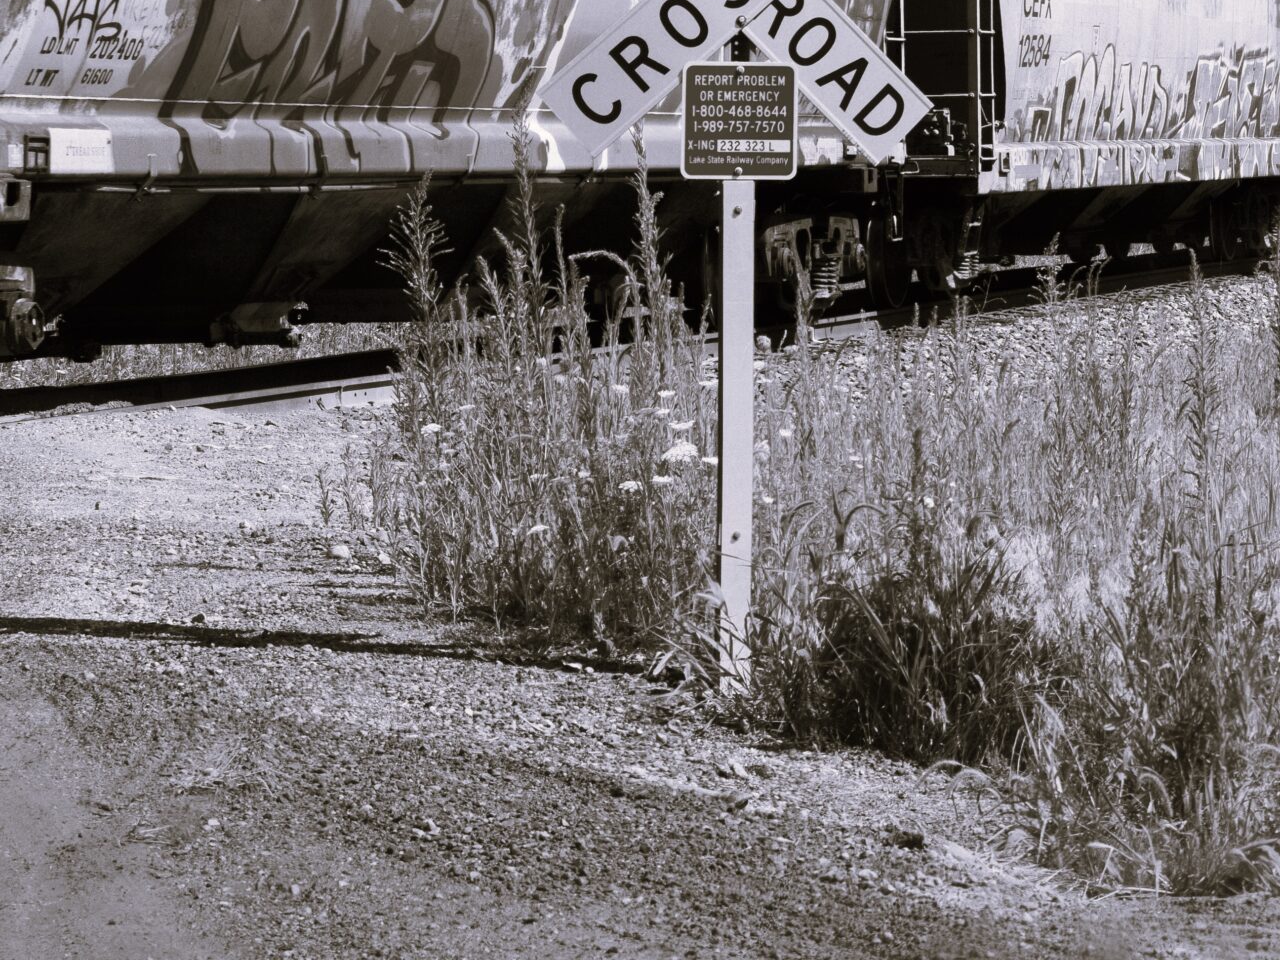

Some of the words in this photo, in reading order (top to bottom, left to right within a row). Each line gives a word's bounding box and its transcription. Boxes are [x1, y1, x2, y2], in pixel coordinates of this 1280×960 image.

[25, 69, 42, 85] LT
[41, 70, 59, 86] WT
[80, 69, 113, 85] 61600
[694, 75, 734, 86] REPORT
[737, 75, 786, 86] PROBLEM
[700, 91, 714, 101] OR
[718, 91, 780, 101] EMERGENCY
[692, 105, 787, 117] 1-800-468-8644
[694, 121, 785, 133] 1-989-757-7570
[687, 140, 715, 150] X-ING
[720, 141, 740, 151] 232
[745, 141, 765, 151] 323
[768, 141, 775, 151] L
[689, 156, 705, 164] Lake
[707, 156, 725, 164] State
[726, 156, 754, 165] Railway
[756, 156, 789, 166] Company
